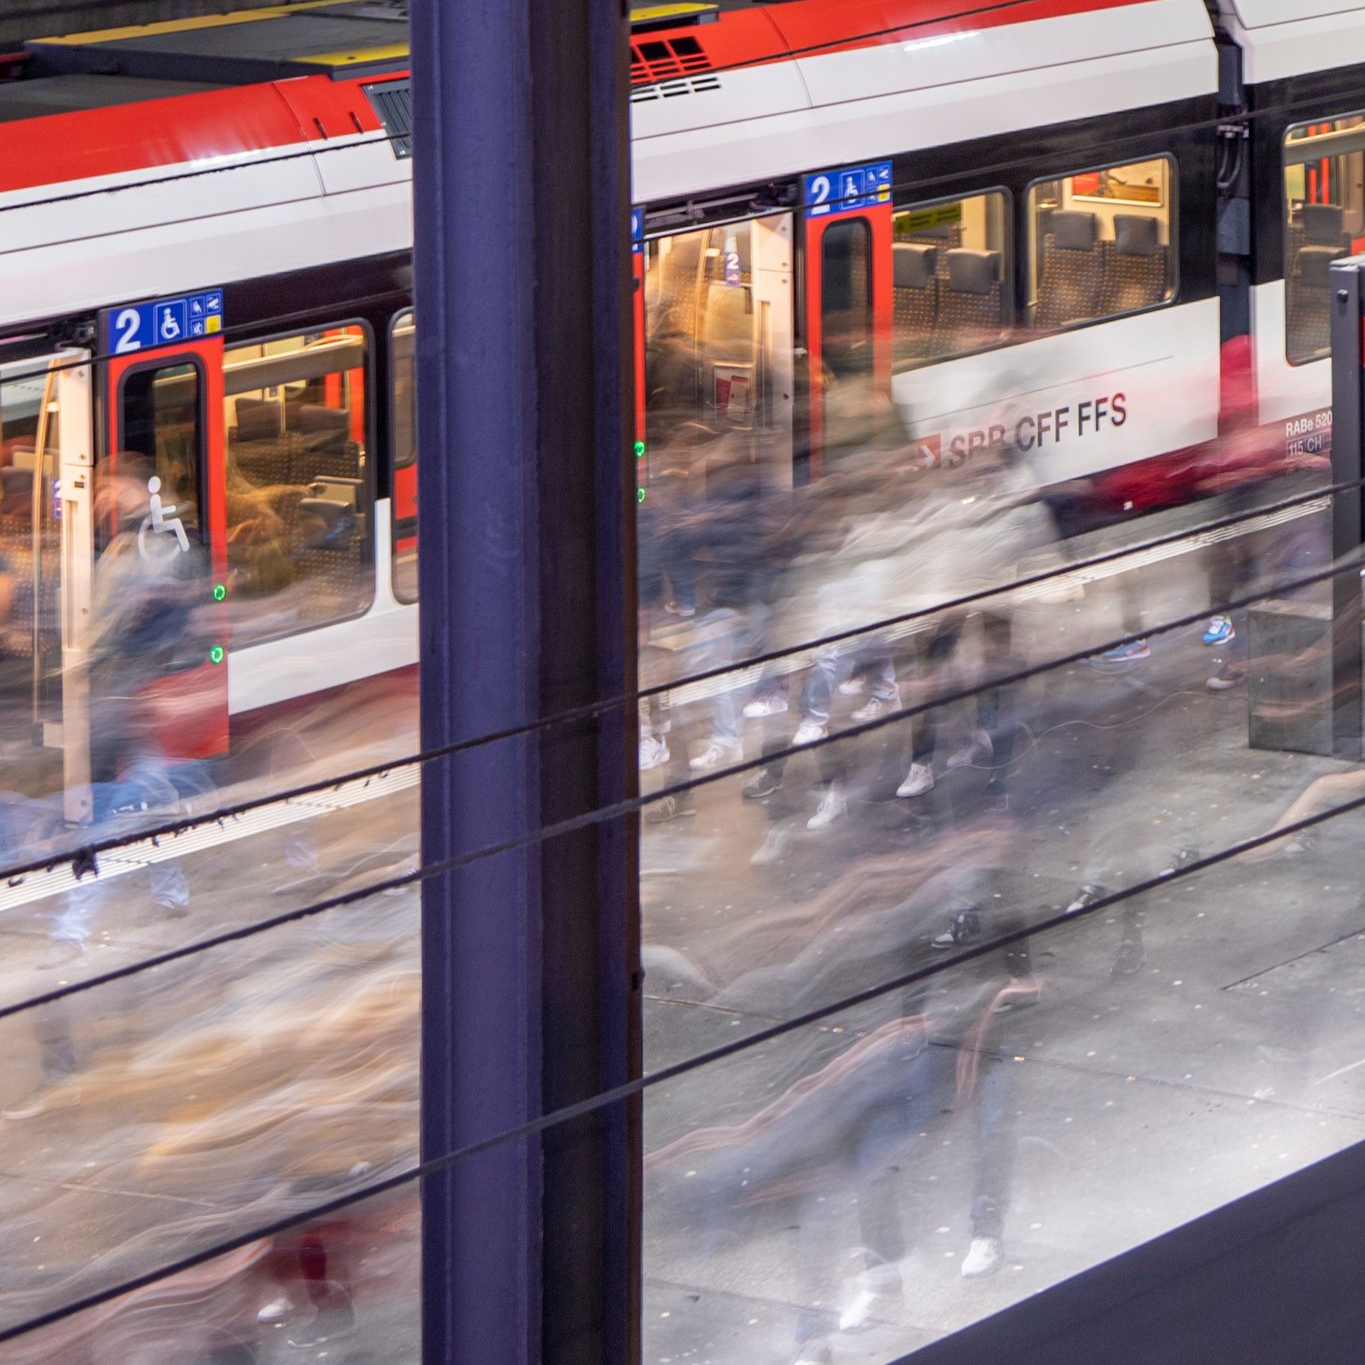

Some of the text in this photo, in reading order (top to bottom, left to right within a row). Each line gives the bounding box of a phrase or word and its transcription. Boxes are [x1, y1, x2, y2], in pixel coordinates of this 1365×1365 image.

[810, 176, 831, 215] 2
[727, 253, 740, 270] 2
[115, 308, 141, 354] 2
[1016, 407, 1070, 452] CFF
[1078, 392, 1127, 437] FFS
[1285, 412, 1333, 437] RABe 520
[1306, 436, 1322, 452] CH
